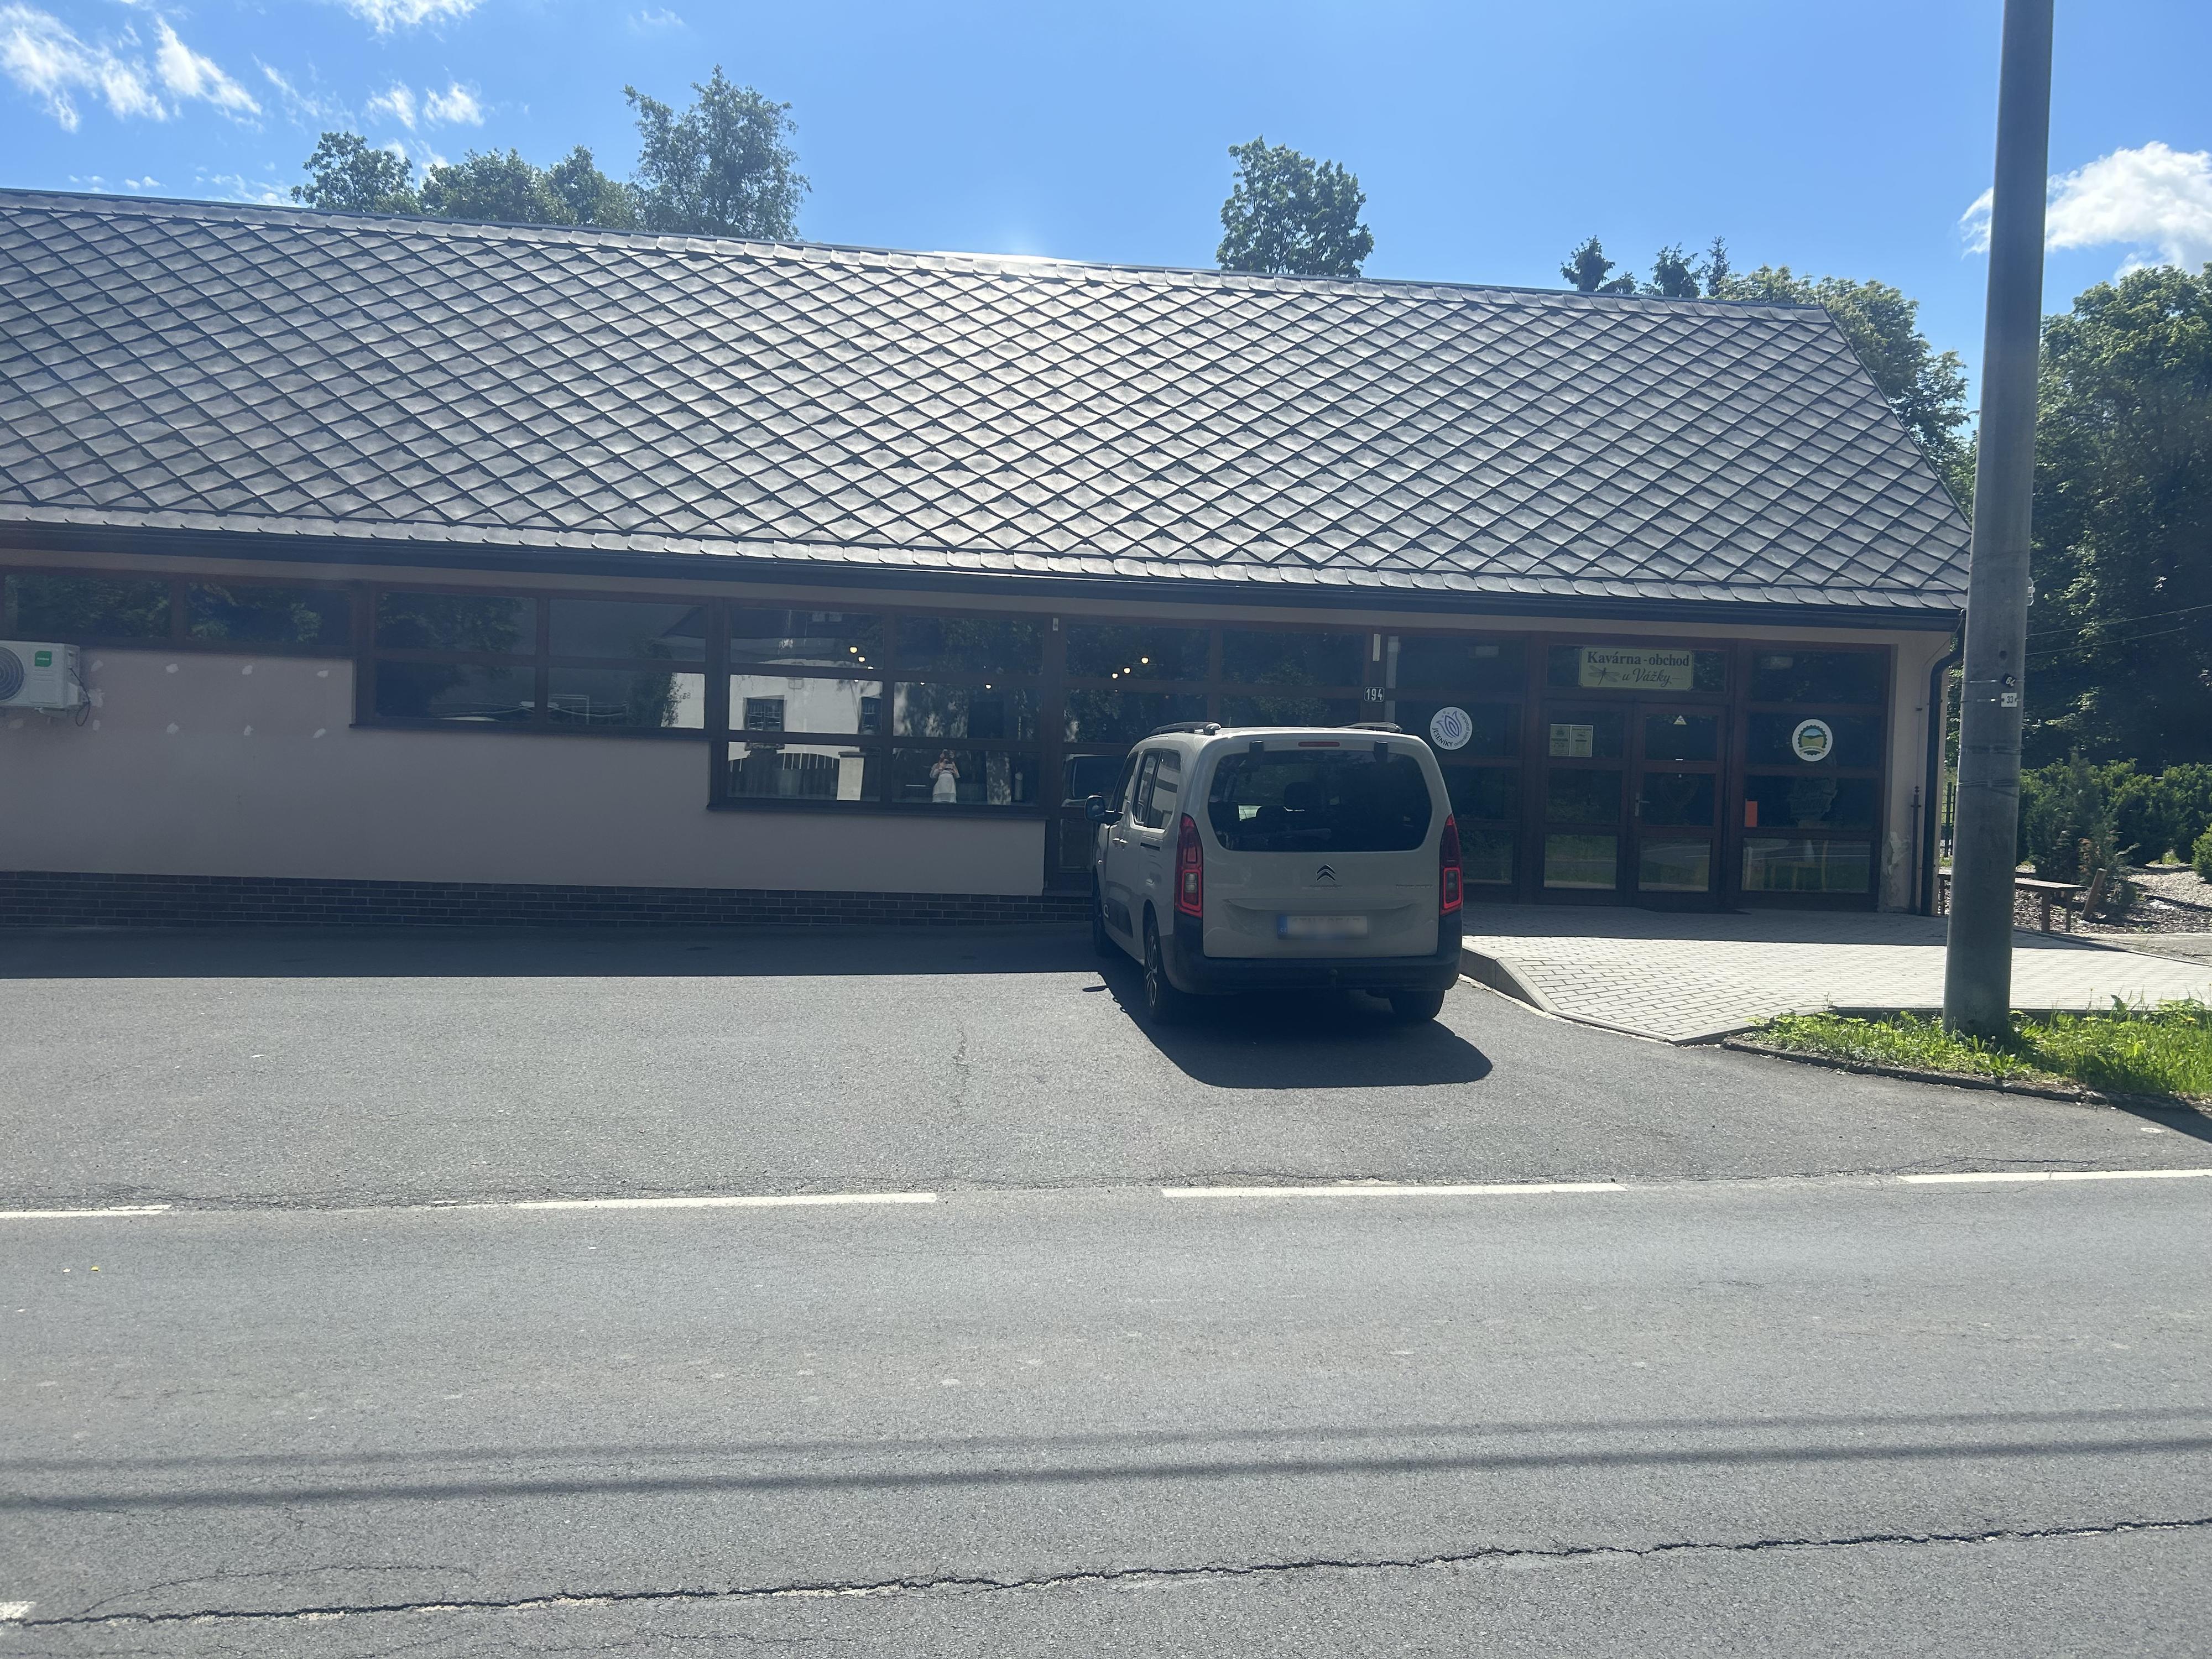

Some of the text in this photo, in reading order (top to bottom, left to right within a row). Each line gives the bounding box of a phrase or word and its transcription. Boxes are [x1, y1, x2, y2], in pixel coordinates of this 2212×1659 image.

[1588, 651, 1641, 665] Kavárna
[1632, 667, 1672, 687] Vážky
[1366, 688, 1383, 701] 194
[2006, 696, 2013, 704] 33
[1432, 727, 1453, 747] JESENÍKY
